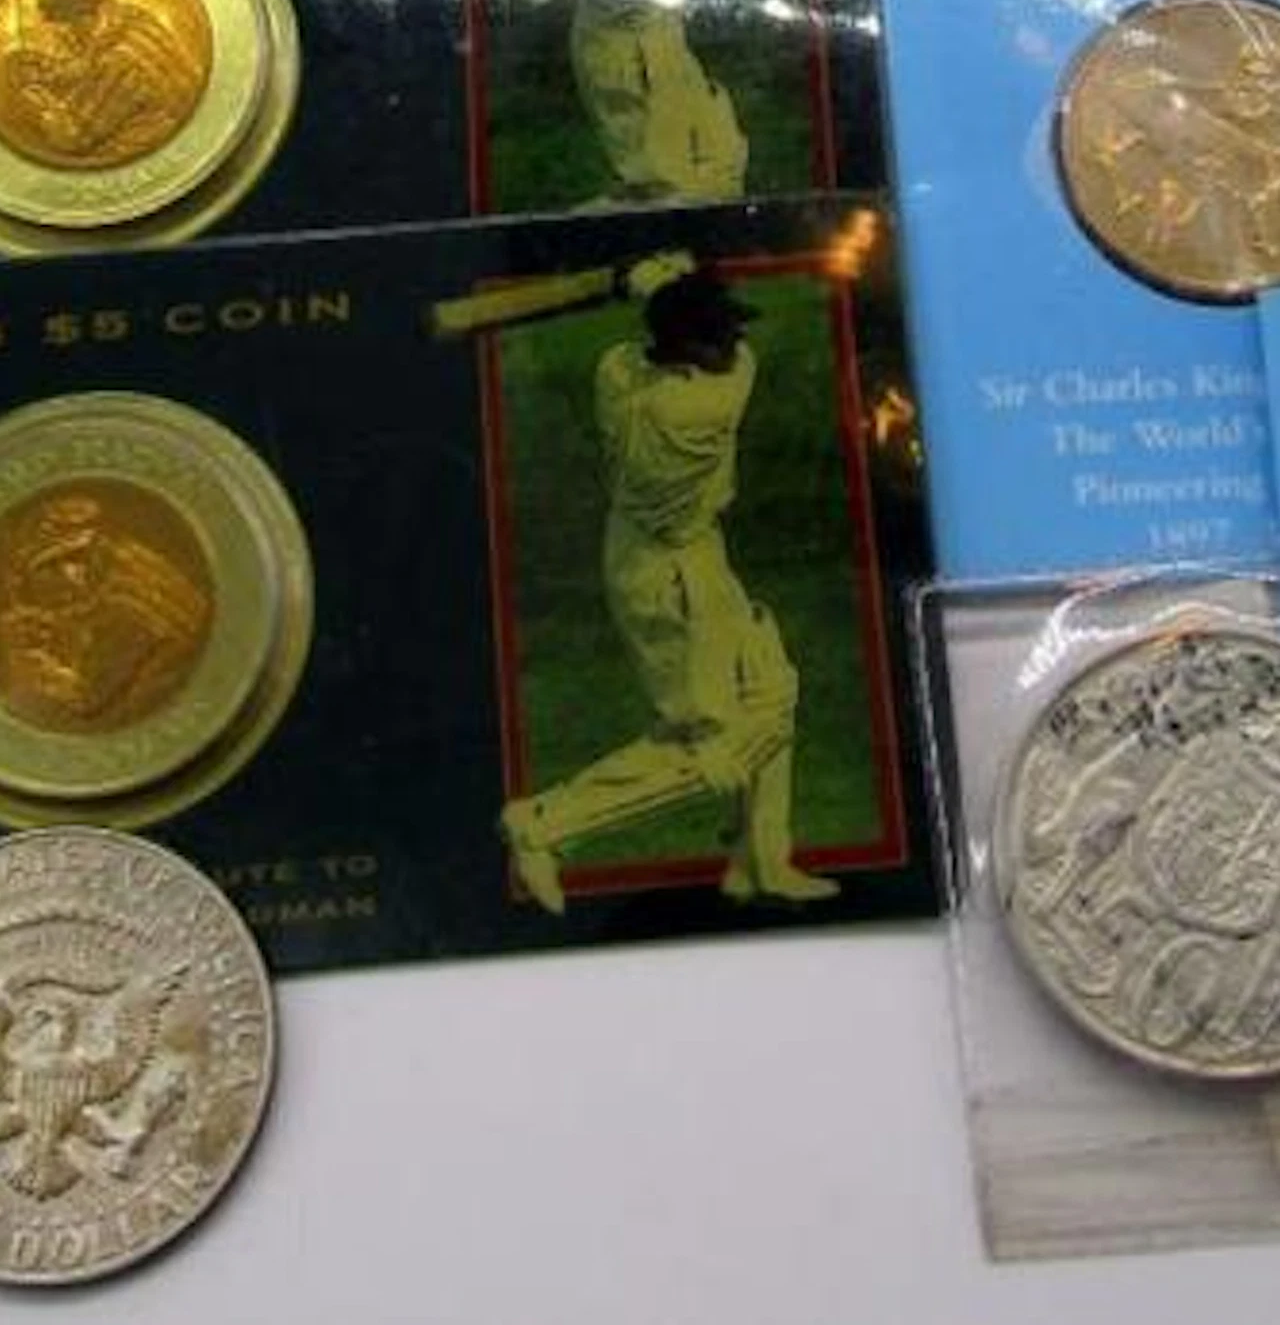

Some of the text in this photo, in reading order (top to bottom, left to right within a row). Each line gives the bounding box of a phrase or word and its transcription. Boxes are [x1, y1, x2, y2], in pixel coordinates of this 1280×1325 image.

[42, 308, 129, 345] $5
[164, 292, 351, 334] COIN
[1053, 419, 1116, 458] The
